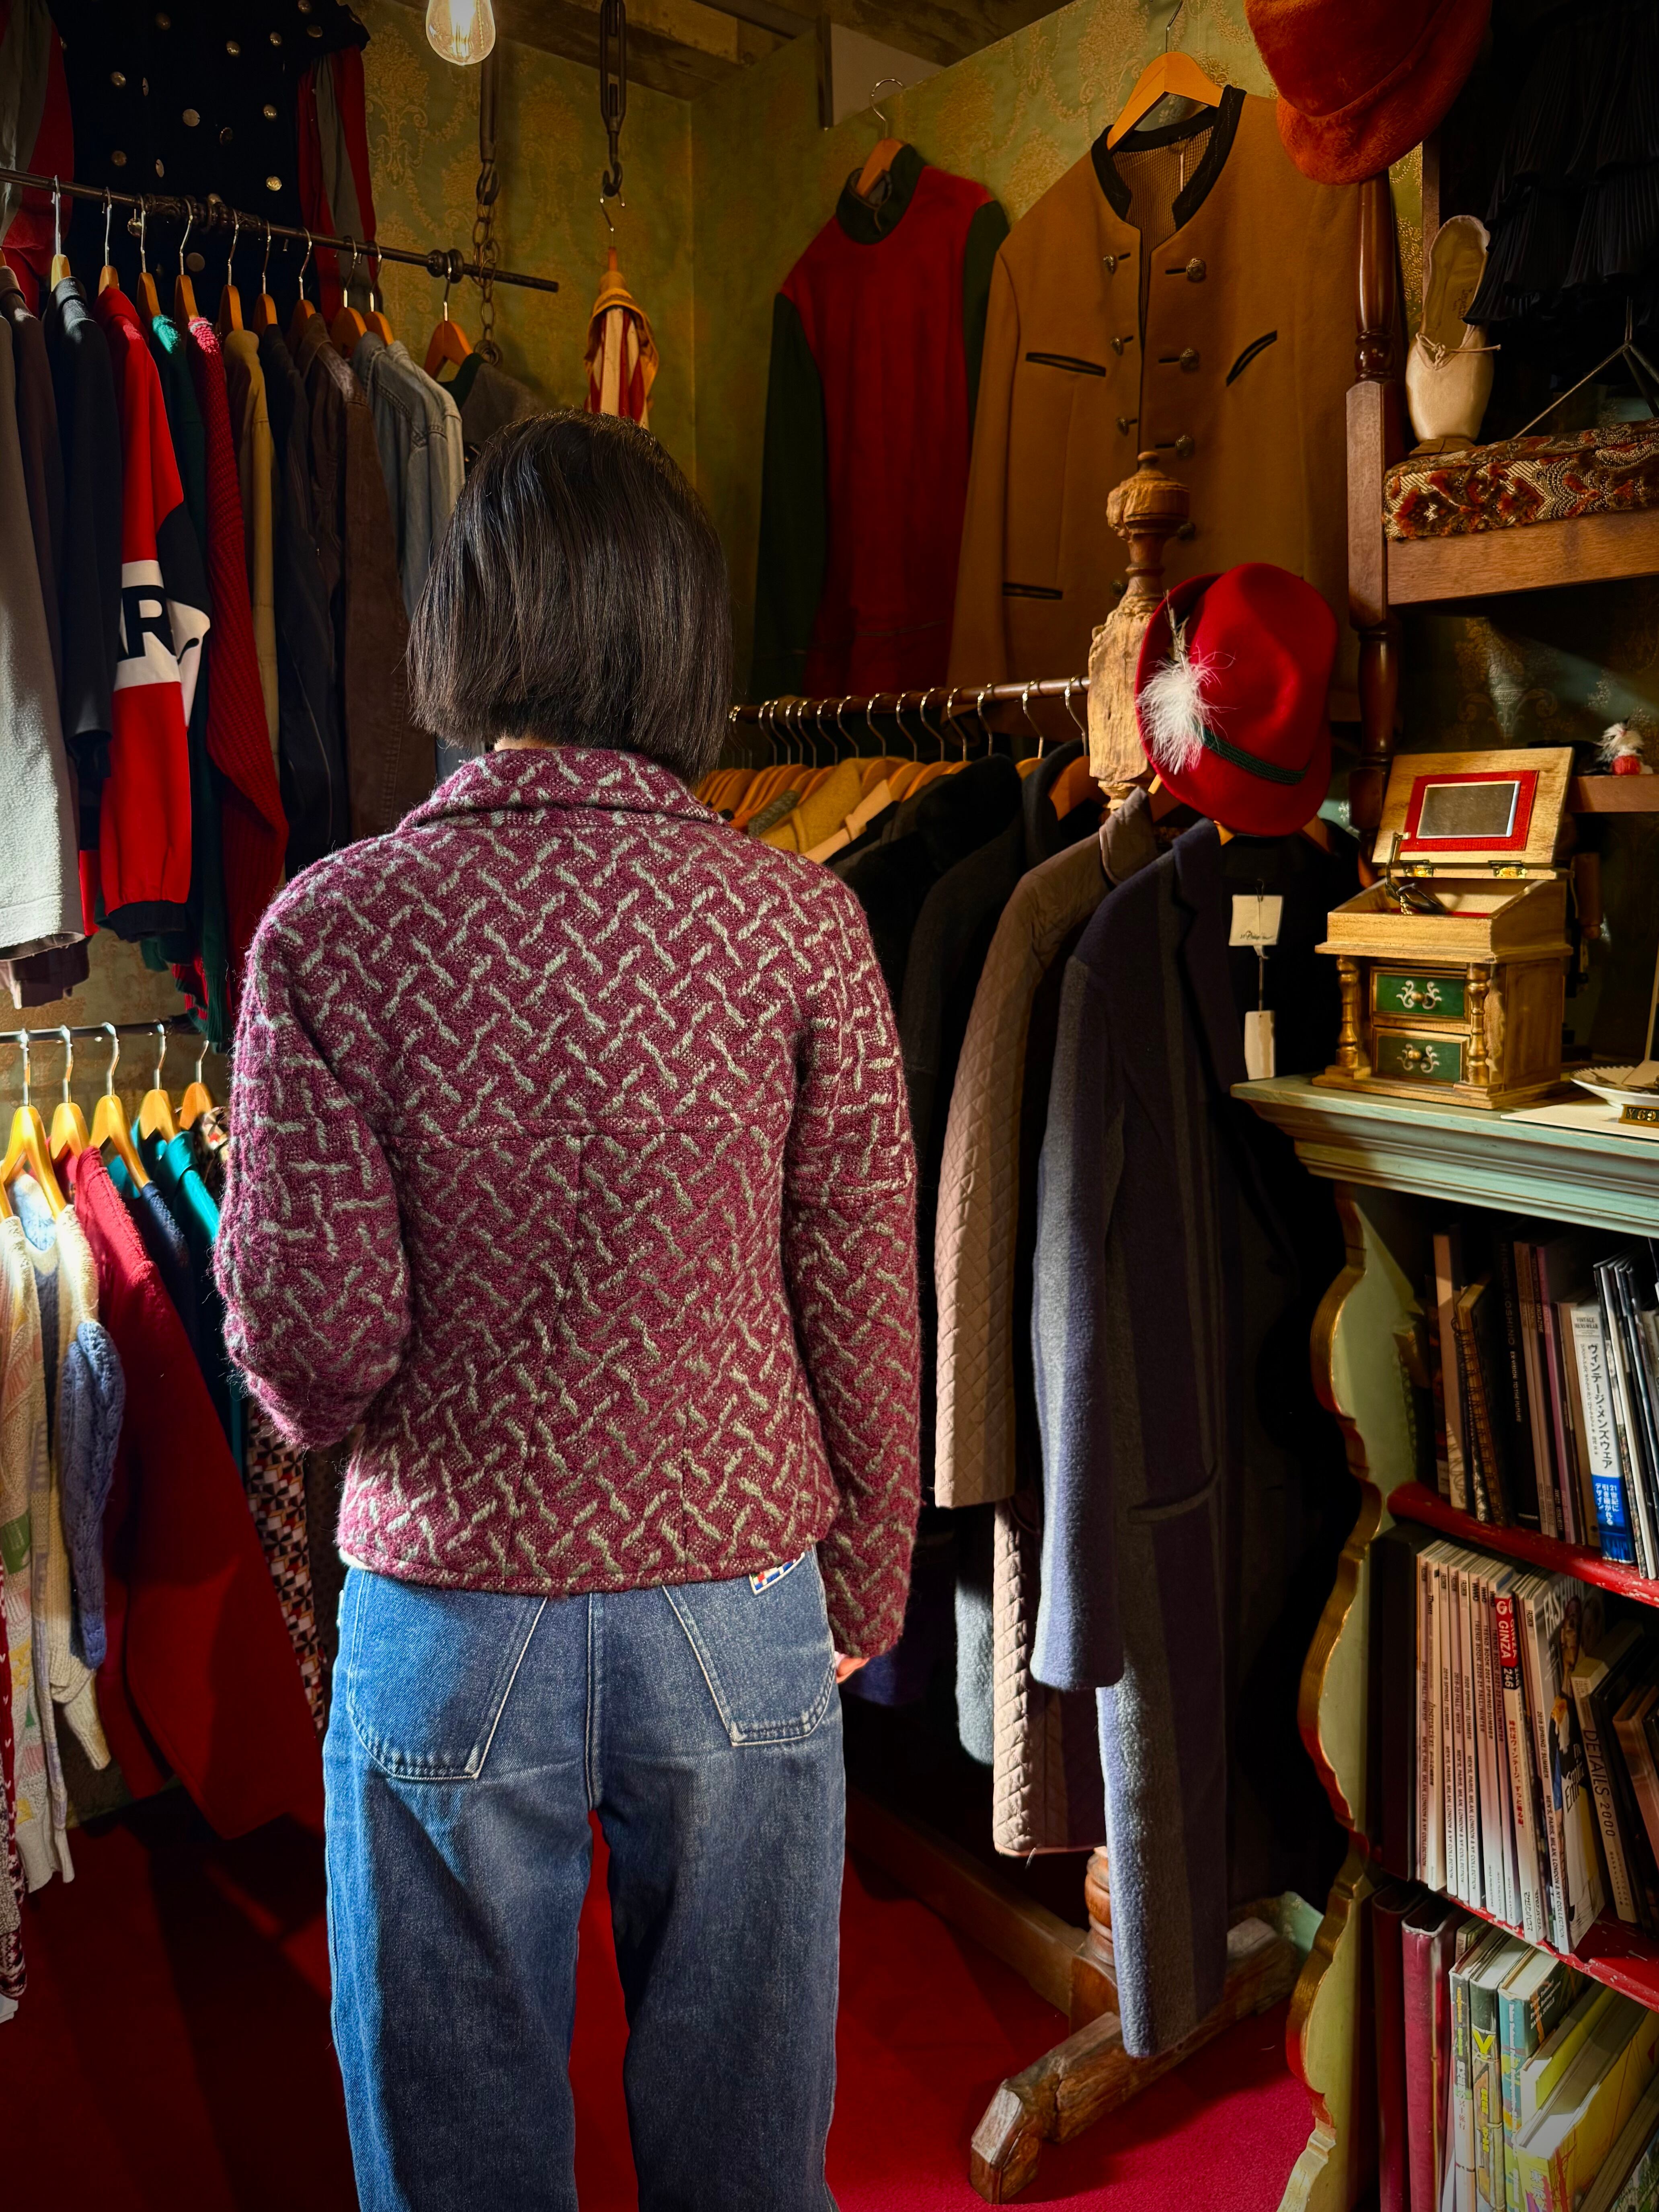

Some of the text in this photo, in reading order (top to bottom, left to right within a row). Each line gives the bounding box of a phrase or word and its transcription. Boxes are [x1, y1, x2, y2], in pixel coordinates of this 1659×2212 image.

[1588, 1343, 1612, 1469] ヴィンテージ・メンズウェア
[1498, 1620, 1512, 1659] GINZA
[1503, 1667, 1514, 1688] 246
[1583, 1729, 1610, 1795] DETAILS
[1600, 1803, 1616, 1837] 2000
[1541, 1752, 1549, 1779] SUMMER
[1552, 1859, 1560, 1885] LONDON
[1556, 1900, 1565, 1939] COLLECTION
